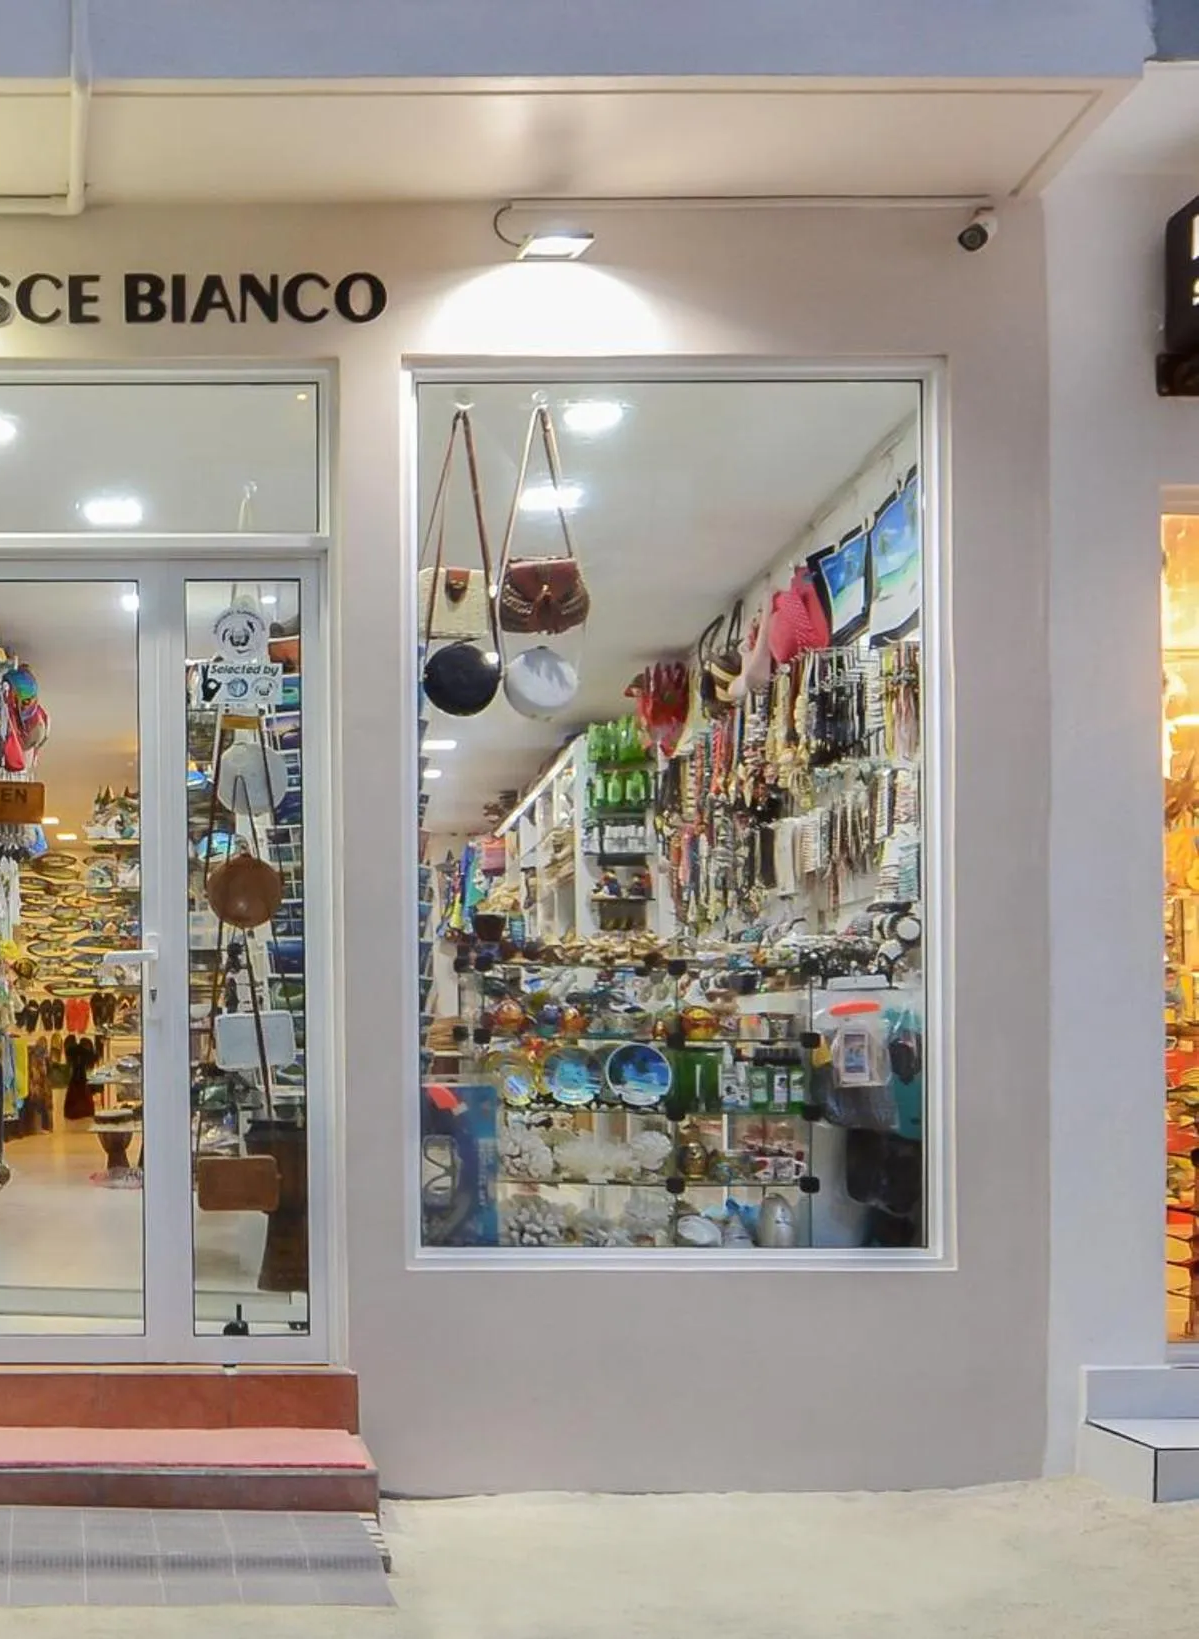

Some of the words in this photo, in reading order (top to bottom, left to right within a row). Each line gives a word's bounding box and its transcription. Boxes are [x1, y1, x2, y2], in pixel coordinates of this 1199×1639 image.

[123, 271, 388, 325] BIANCO
[210, 664, 261, 675] Selected
[263, 664, 280, 677] by
